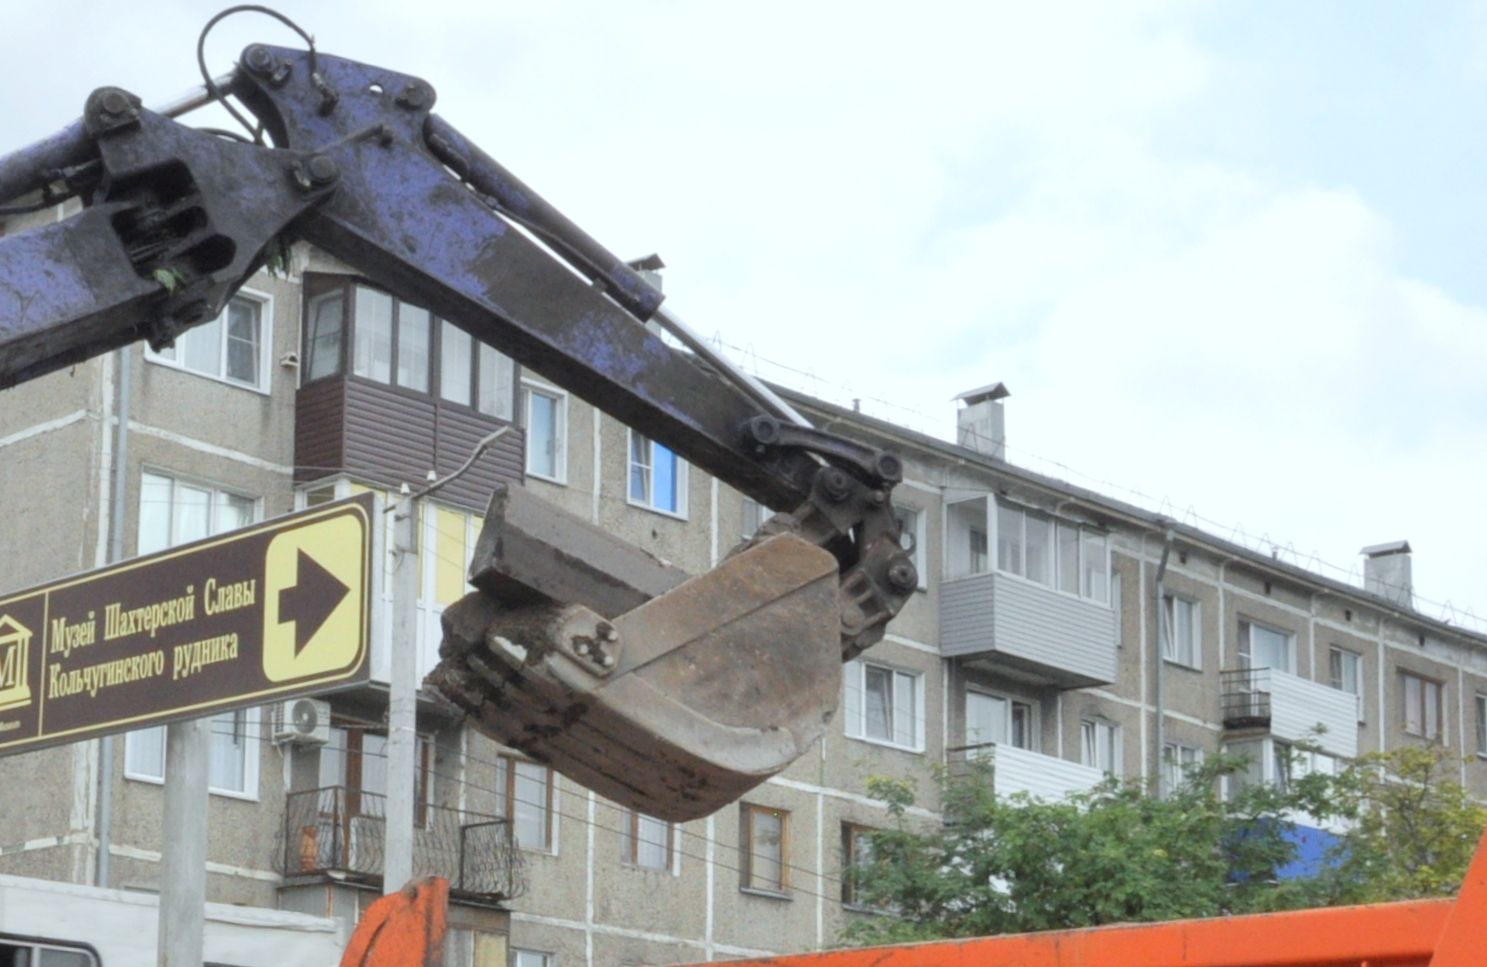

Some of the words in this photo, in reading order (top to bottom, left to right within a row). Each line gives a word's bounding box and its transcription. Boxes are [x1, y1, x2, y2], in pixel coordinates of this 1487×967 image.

[50, 610, 96, 659] Музей
[103, 584, 196, 638] Шахтерской
[204, 577, 256, 617] Славы
[48, 649, 165, 699] Кольчугинского
[172, 632, 239, 680] рудника
